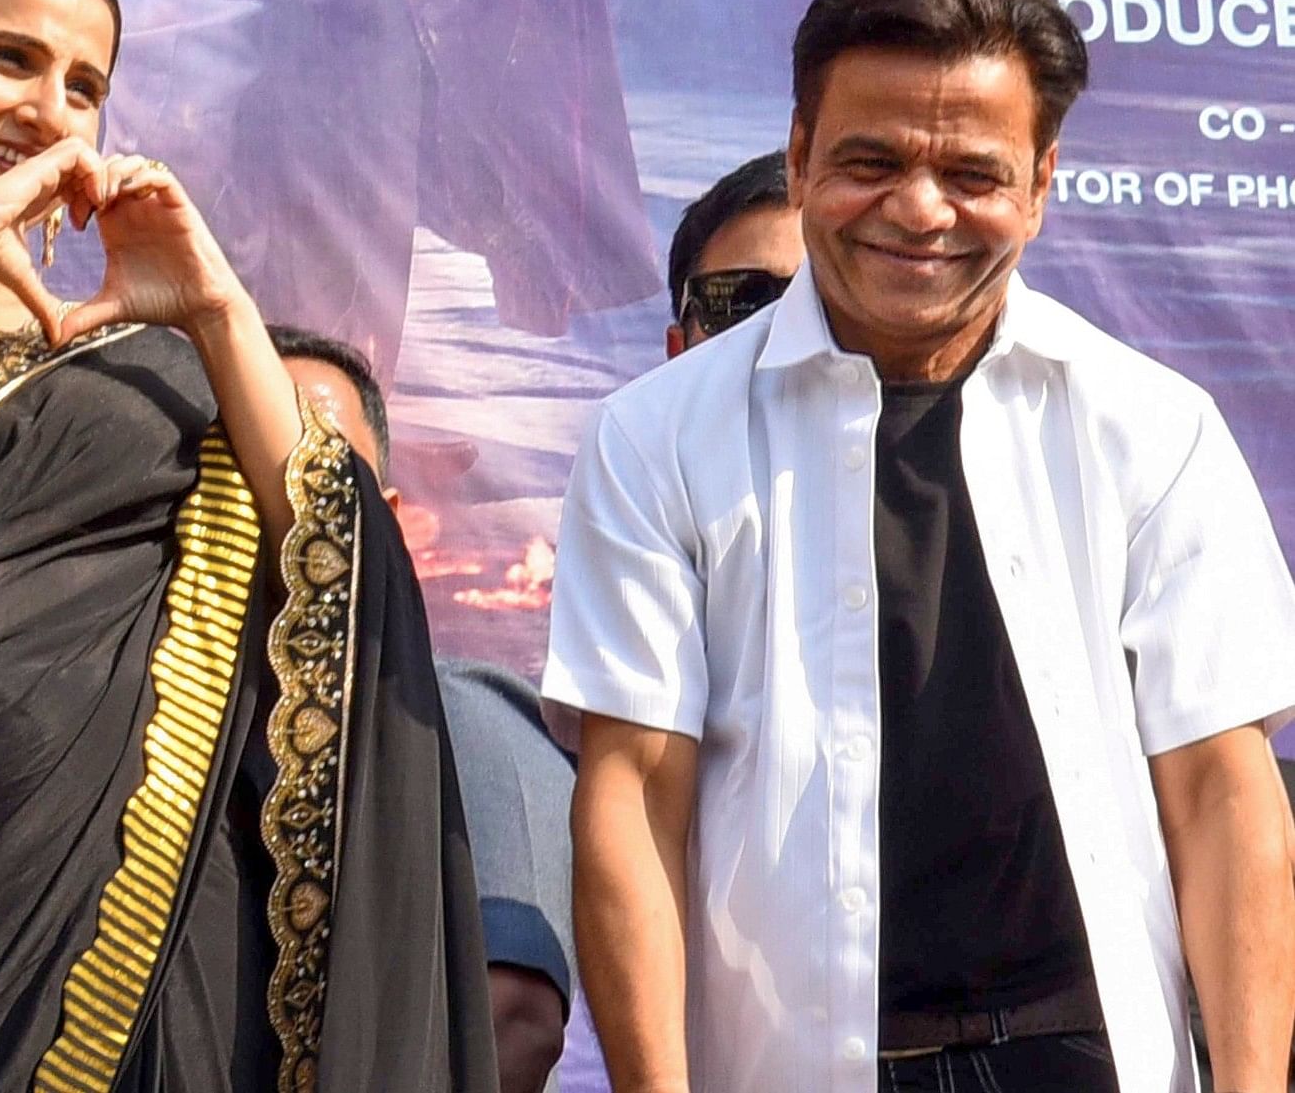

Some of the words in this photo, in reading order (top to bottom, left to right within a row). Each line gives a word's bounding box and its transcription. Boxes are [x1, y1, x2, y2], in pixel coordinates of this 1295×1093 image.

[1199, 106, 1266, 140] CO
[1053, 169, 1143, 205] TOR
[1154, 171, 1215, 206] OF
[1227, 175, 1295, 208] PH
